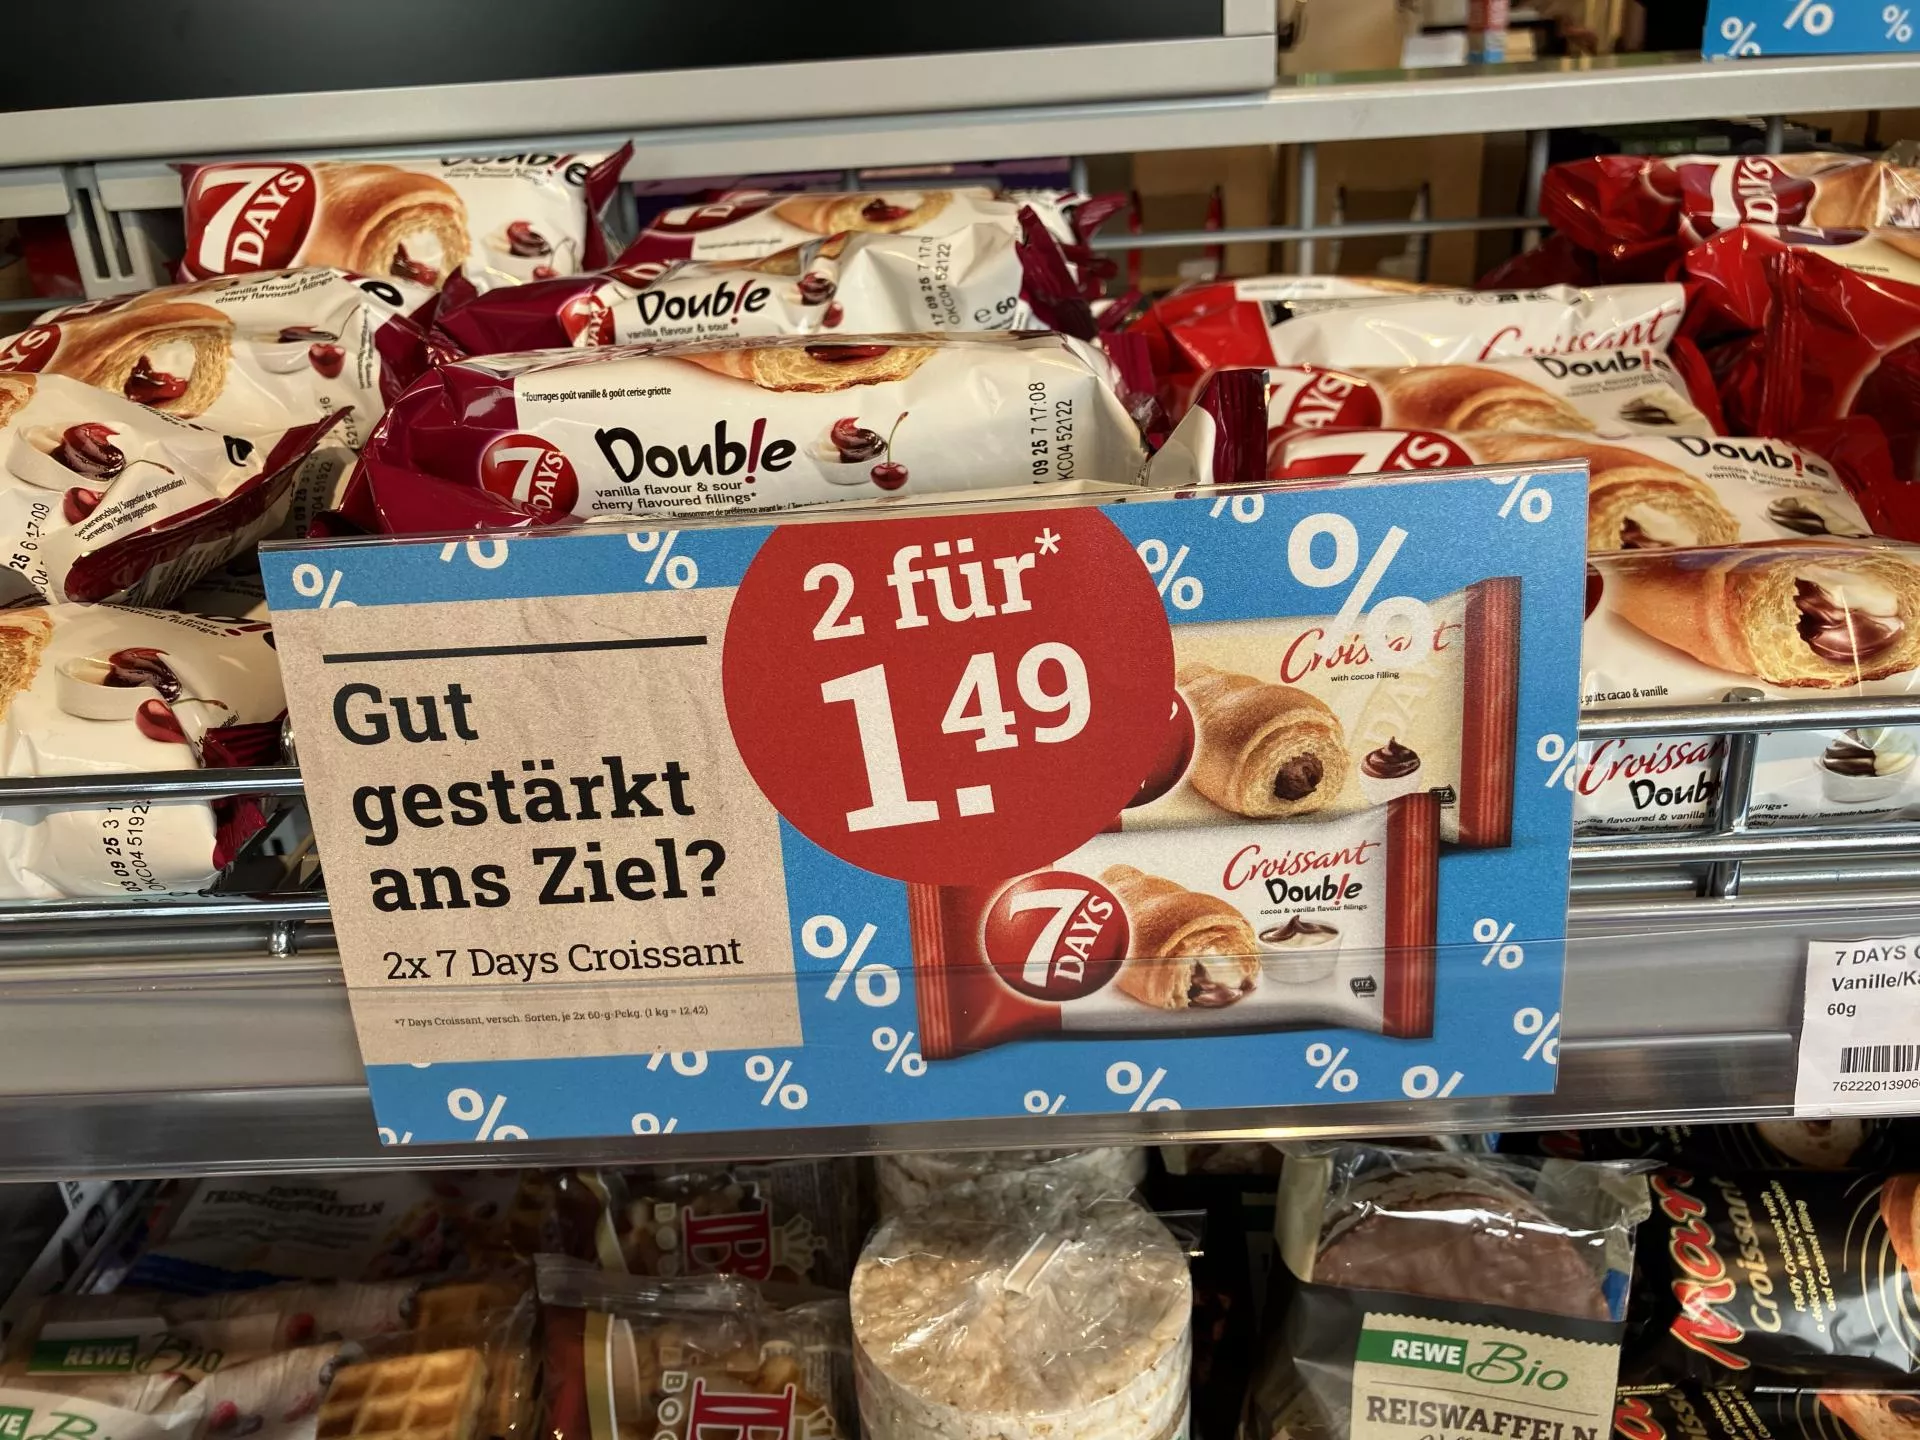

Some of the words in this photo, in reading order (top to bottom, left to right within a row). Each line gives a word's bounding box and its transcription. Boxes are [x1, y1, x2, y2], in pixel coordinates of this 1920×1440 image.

[231, 170, 306, 267] DAYS
[577, 389, 601, 399] vanille
[647, 386, 672, 399] griotte
[1028, 381, 1047, 423] 17:08
[1056, 399, 1073, 442] 52122
[1031, 439, 1049, 455] 25
[1057, 445, 1075, 481] KC04
[1032, 460, 1049, 476] 09
[591, 500, 633, 511] cherry
[638, 495, 701, 509] flavoured
[595, 485, 641, 498] vanilla
[644, 483, 692, 497] flavour
[697, 482, 708, 493] &
[712, 482, 742, 491] sour
[9, 553, 31, 571] 25
[803, 562, 866, 641] 2
[1331, 673, 1349, 682] with
[1350, 672, 1374, 681] cocoa
[1376, 670, 1400, 681] filling
[1607, 691, 1631, 701] cacao
[1640, 685, 1669, 697] vanille
[332, 681, 479, 746] Gut
[352, 755, 696, 846] gestärkt
[1607, 813, 1656, 825] flavoured
[1671, 811, 1706, 820] vanilla
[103, 836, 122, 857] 25
[110, 860, 129, 877] 09
[369, 862, 512, 912] ans
[531, 838, 727, 905] Ziel?
[1222, 840, 1382, 891] Croissant
[1053, 895, 1114, 984] DAYS
[1834, 951, 1847, 966] 7
[1852, 944, 1906, 965] DAYS
[382, 950, 432, 981] 2x
[436, 948, 459, 978] 7
[467, 947, 560, 983] Days
[567, 937, 744, 973] Croissant
[408, 1017, 433, 1028] Days
[562, 1011, 571, 1023] je
[655, 1007, 669, 1018] kg
[1827, 1002, 1857, 1017] 60g
[1708, 1175, 1782, 1333] Croissant
[1771, 1217, 1798, 1275] Croissant
[1806, 1233, 1831, 1287] Caramel
[1789, 1275, 1807, 1313] Fluffy
[1804, 1269, 1824, 1322] delicious
[1821, 1286, 1837, 1312] and
[63, 1344, 132, 1366] REWE
[1390, 1338, 1462, 1366] REWE
[1466, 1340, 1570, 1392] Bio
